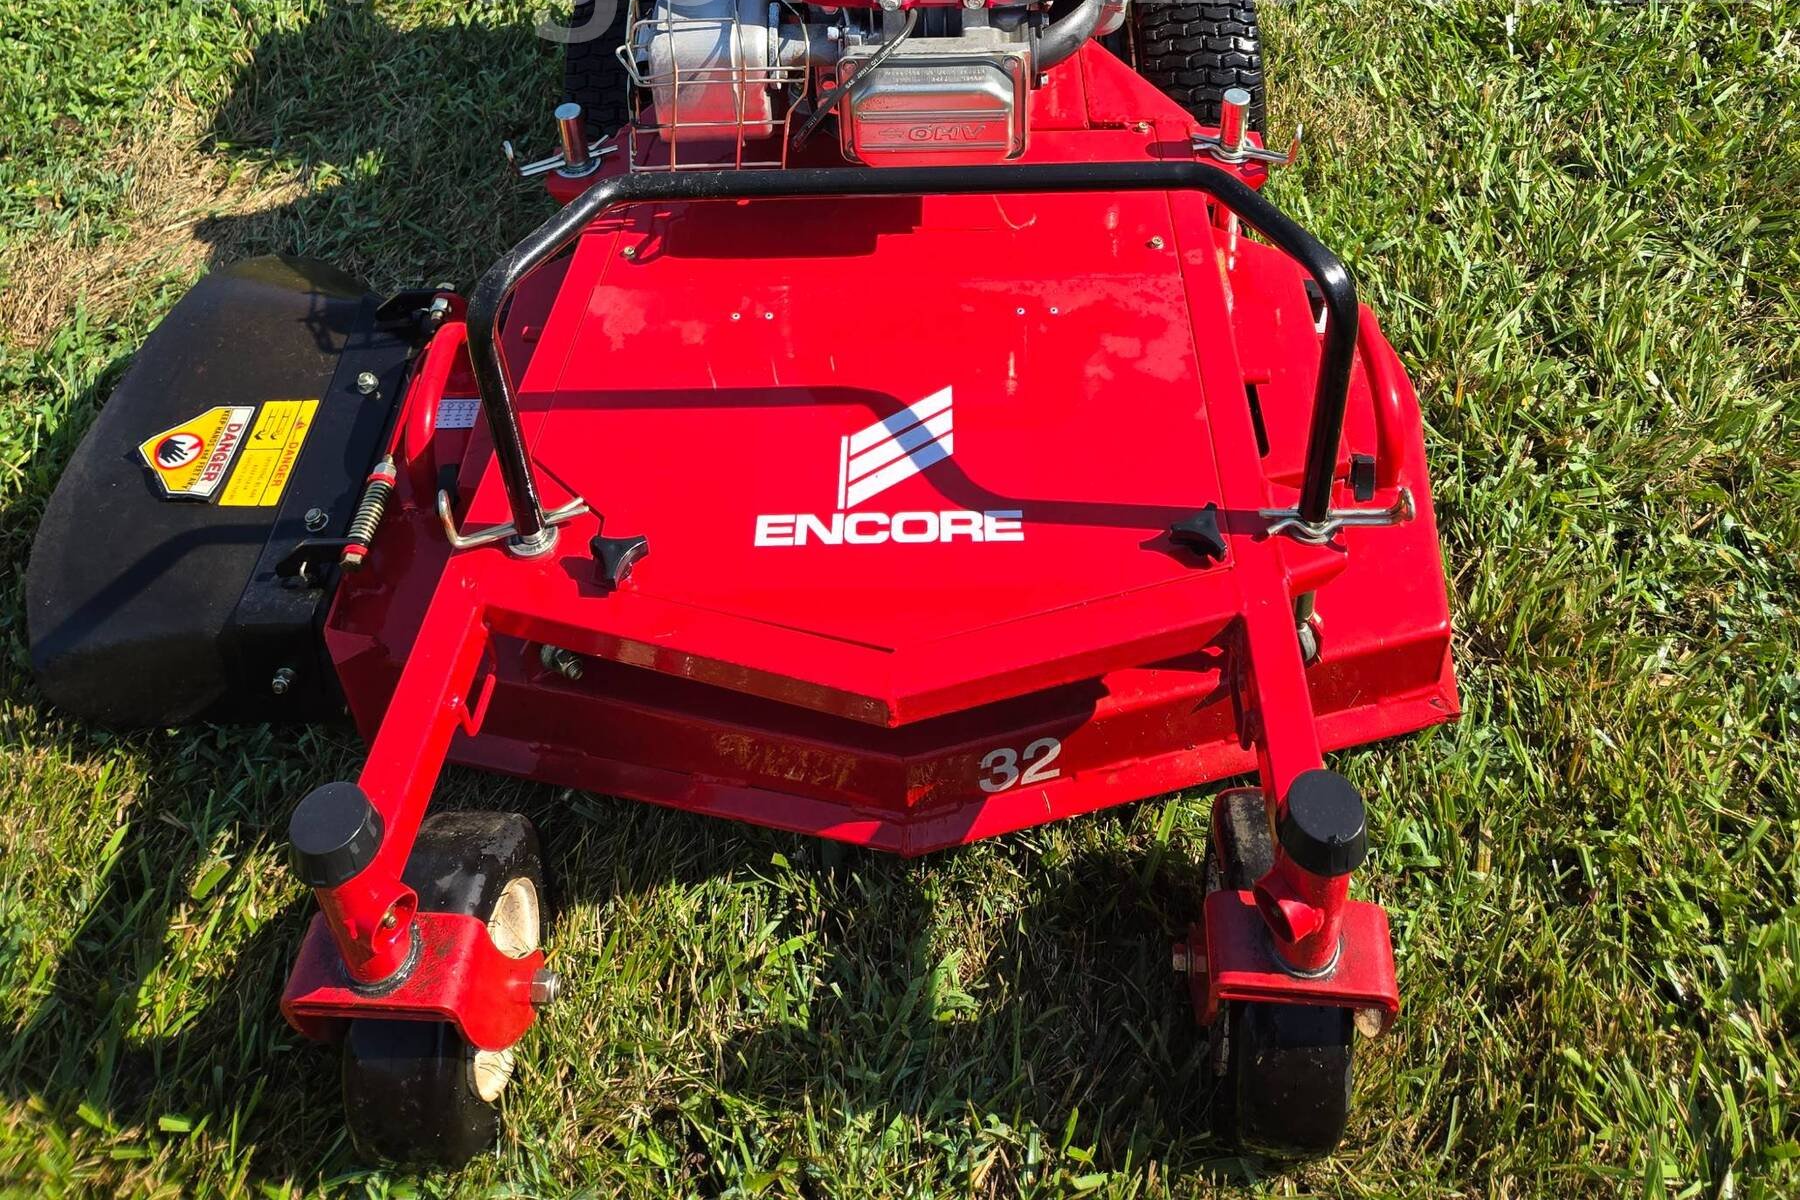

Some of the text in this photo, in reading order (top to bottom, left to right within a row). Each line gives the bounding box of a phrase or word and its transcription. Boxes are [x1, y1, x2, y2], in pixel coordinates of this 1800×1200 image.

[908, 124, 986, 141] OHV
[200, 423, 243, 482] DANGER
[271, 441, 299, 488] DANGER
[754, 510, 1025, 547] ENCORE
[977, 737, 1062, 793] 32
